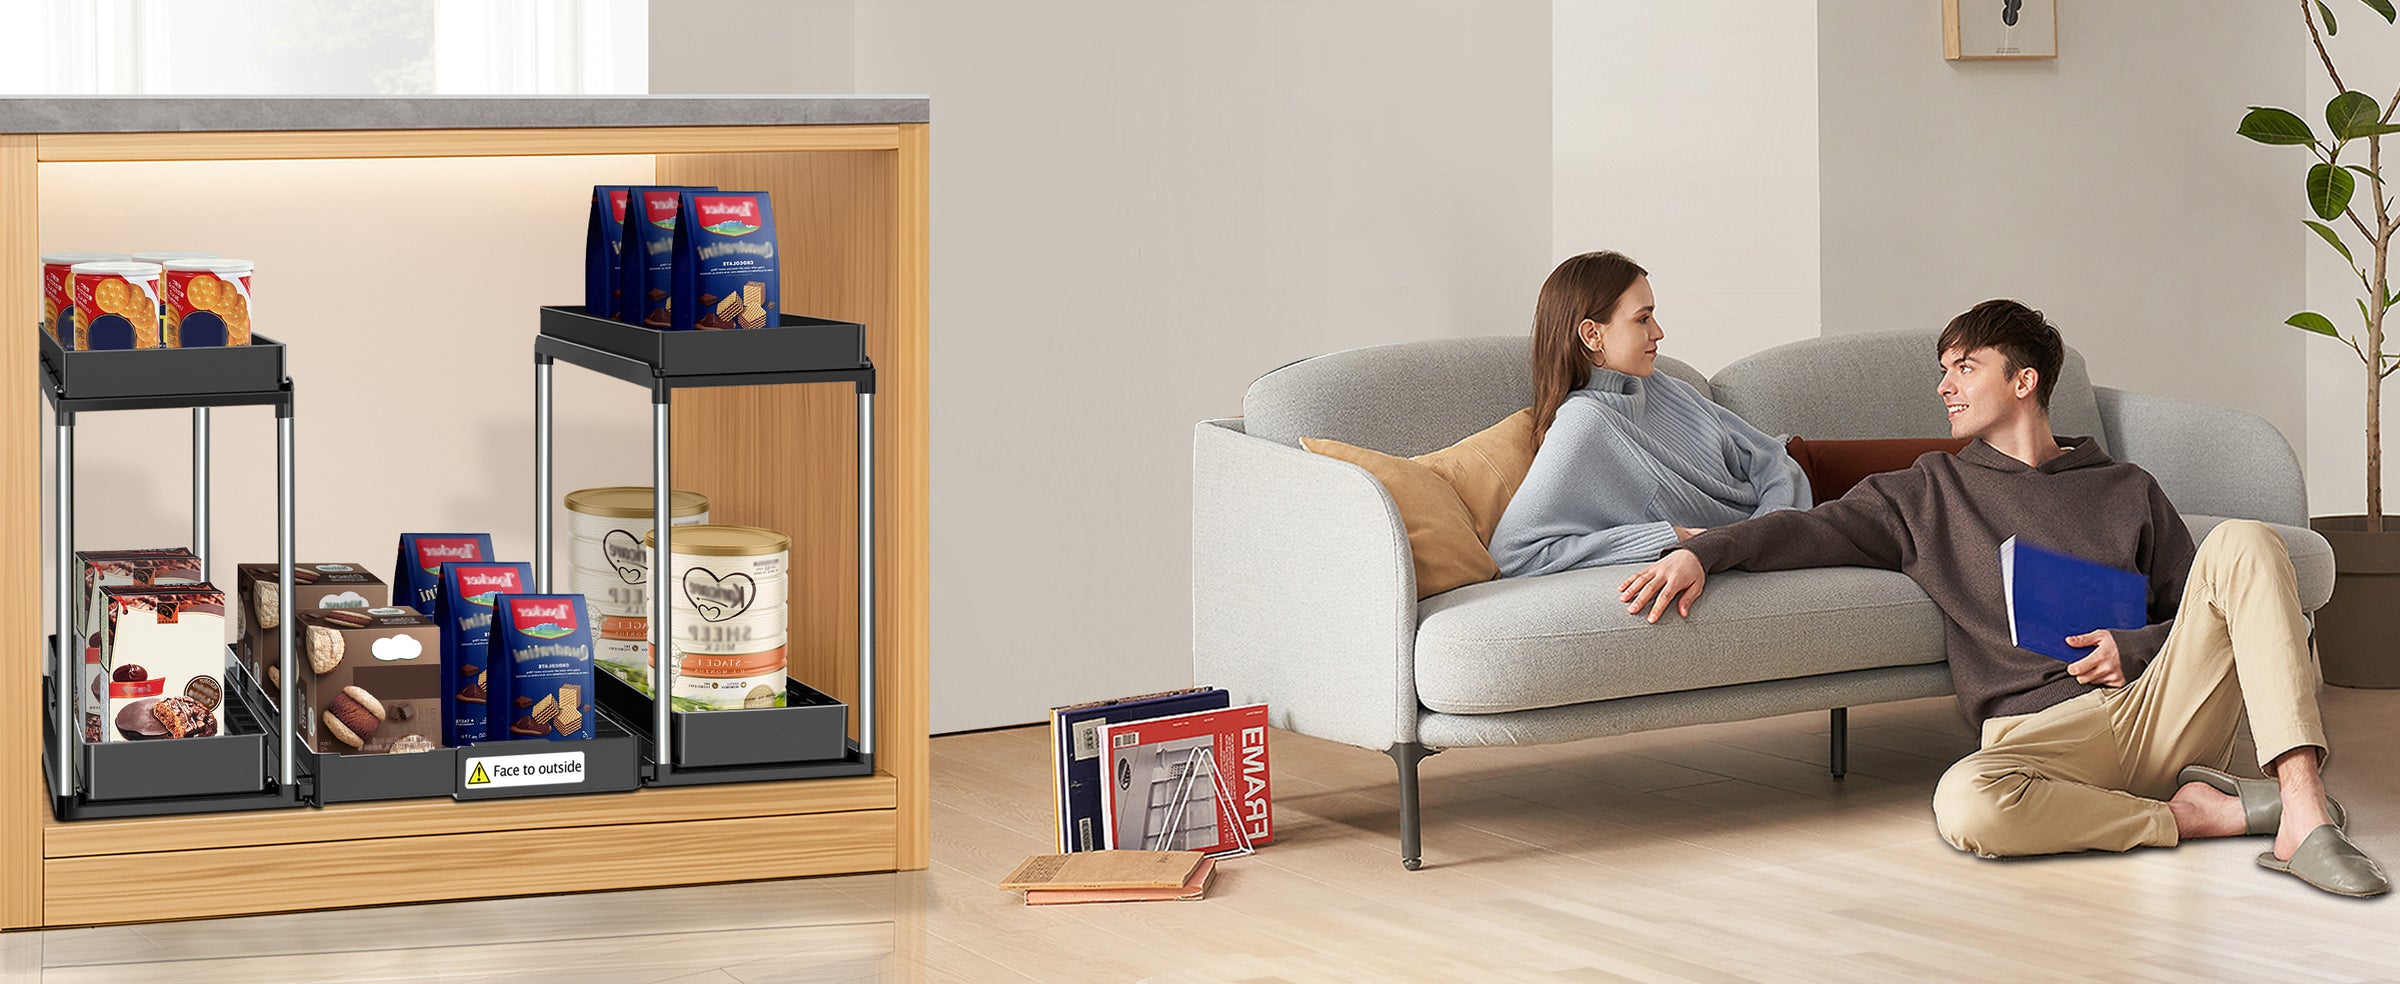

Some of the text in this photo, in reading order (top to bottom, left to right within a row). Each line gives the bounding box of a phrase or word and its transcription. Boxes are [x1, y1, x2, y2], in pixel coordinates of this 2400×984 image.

[494, 760, 582, 777] Face to outside
